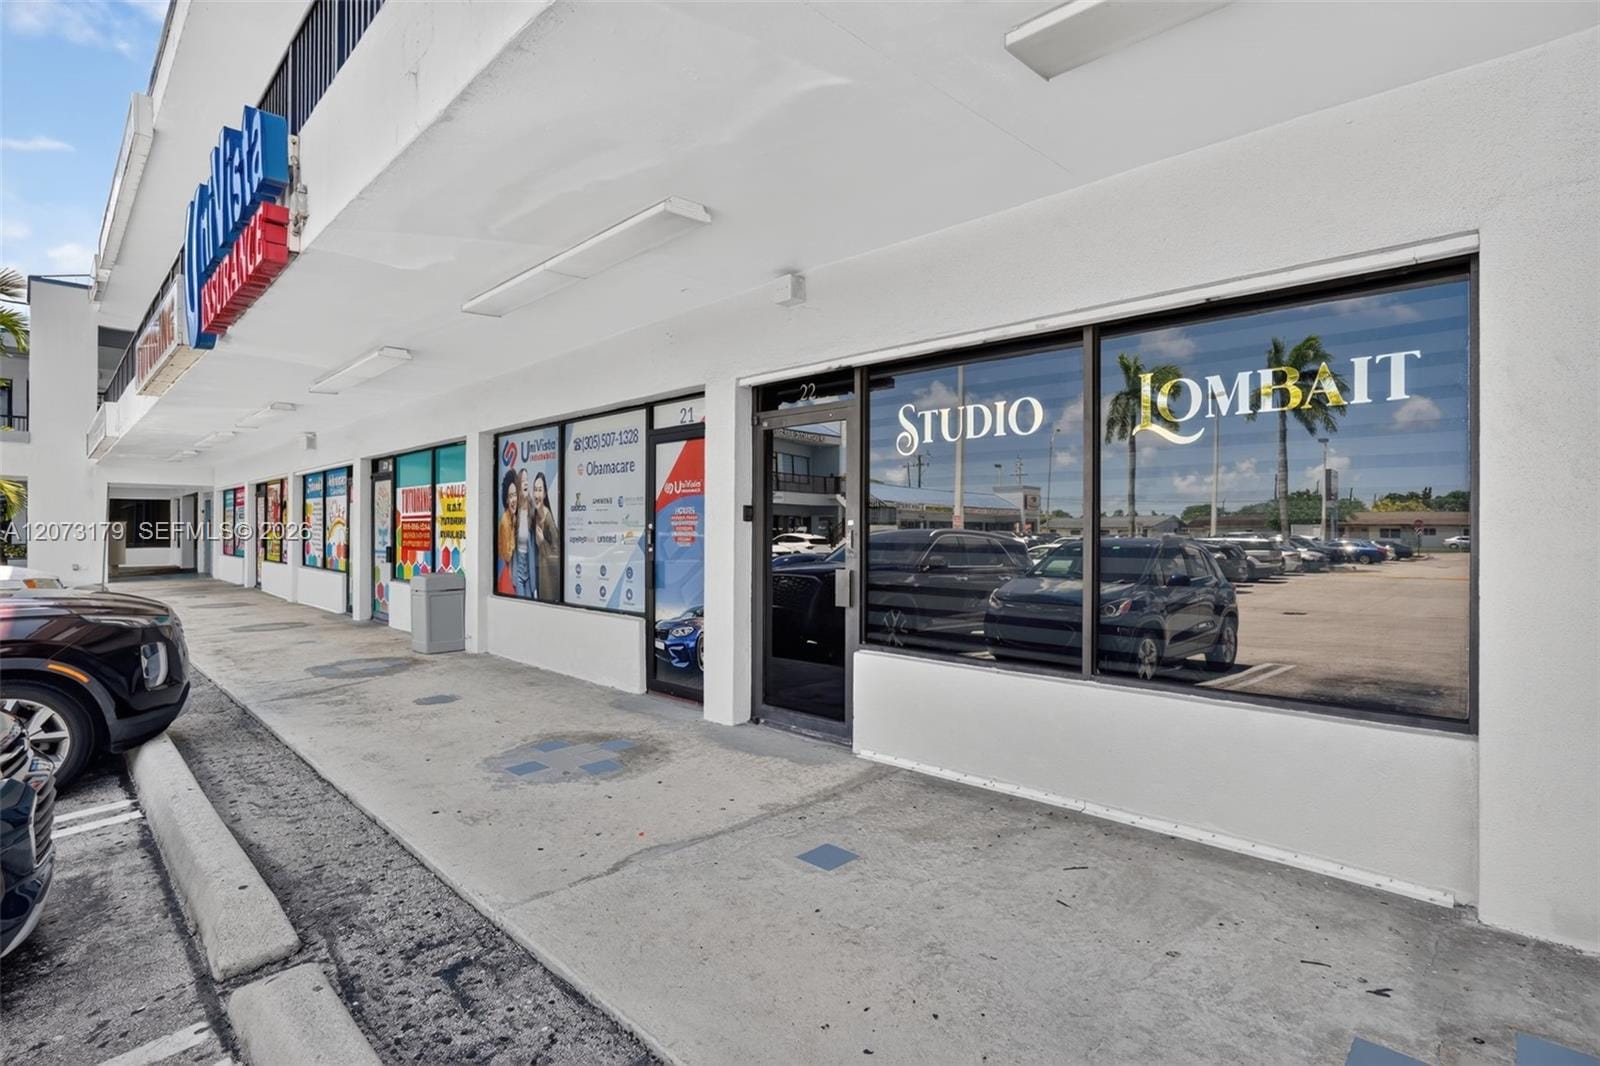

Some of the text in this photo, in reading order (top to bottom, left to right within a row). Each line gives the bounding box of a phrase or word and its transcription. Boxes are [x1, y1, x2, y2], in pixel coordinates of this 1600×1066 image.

[184, 110, 263, 348] UniVista
[201, 209, 264, 332] INSURANCE
[799, 382, 816, 401] 22
[1132, 350, 1422, 445] LOMBAIT
[679, 407, 694, 424] 21
[896, 396, 1044, 456] STUDIO
[520, 439, 556, 463] UniVista
[586, 460, 635, 476] Obamacare
